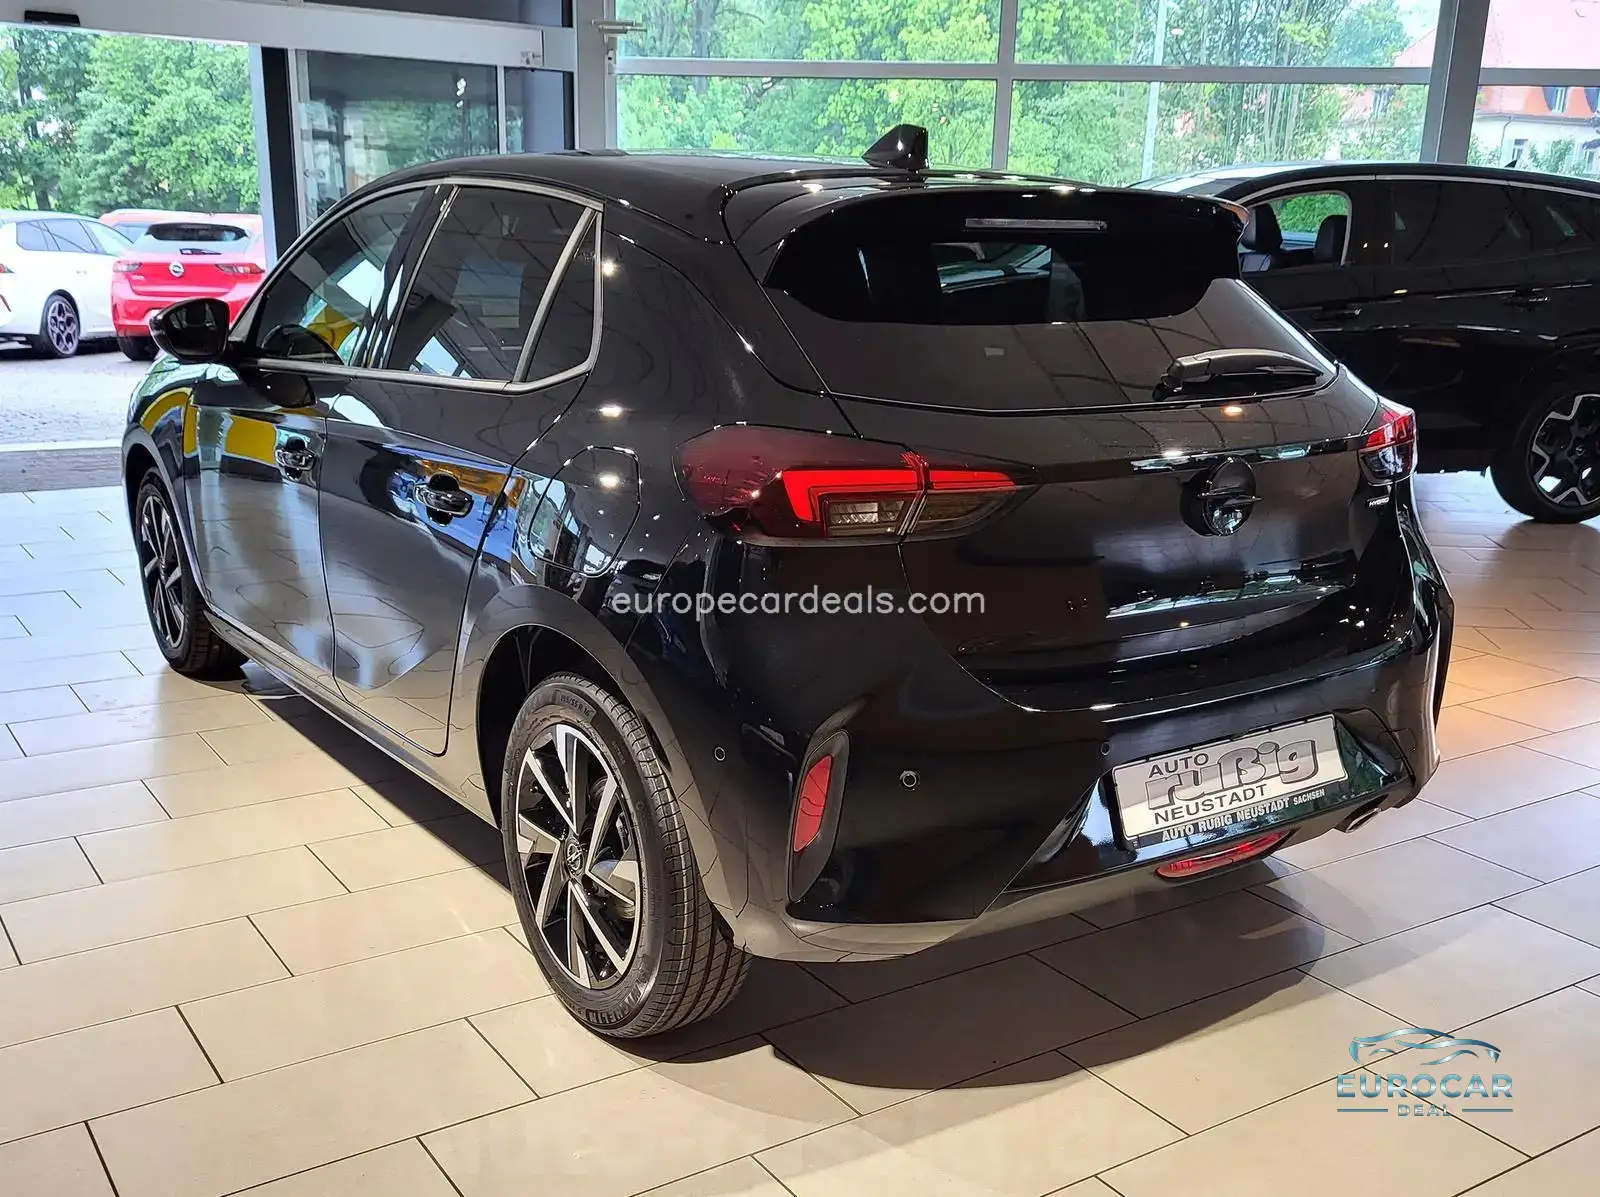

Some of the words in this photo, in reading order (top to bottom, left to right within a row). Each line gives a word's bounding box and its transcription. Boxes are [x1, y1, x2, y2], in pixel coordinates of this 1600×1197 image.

[1150, 752, 1209, 778] AUTO
[1154, 784, 1268, 825] NEUSTADT
[1161, 825, 1195, 842] AUTO
[1236, 798, 1290, 822] NEUSTADT
[1293, 788, 1326, 806] SACHSEN
